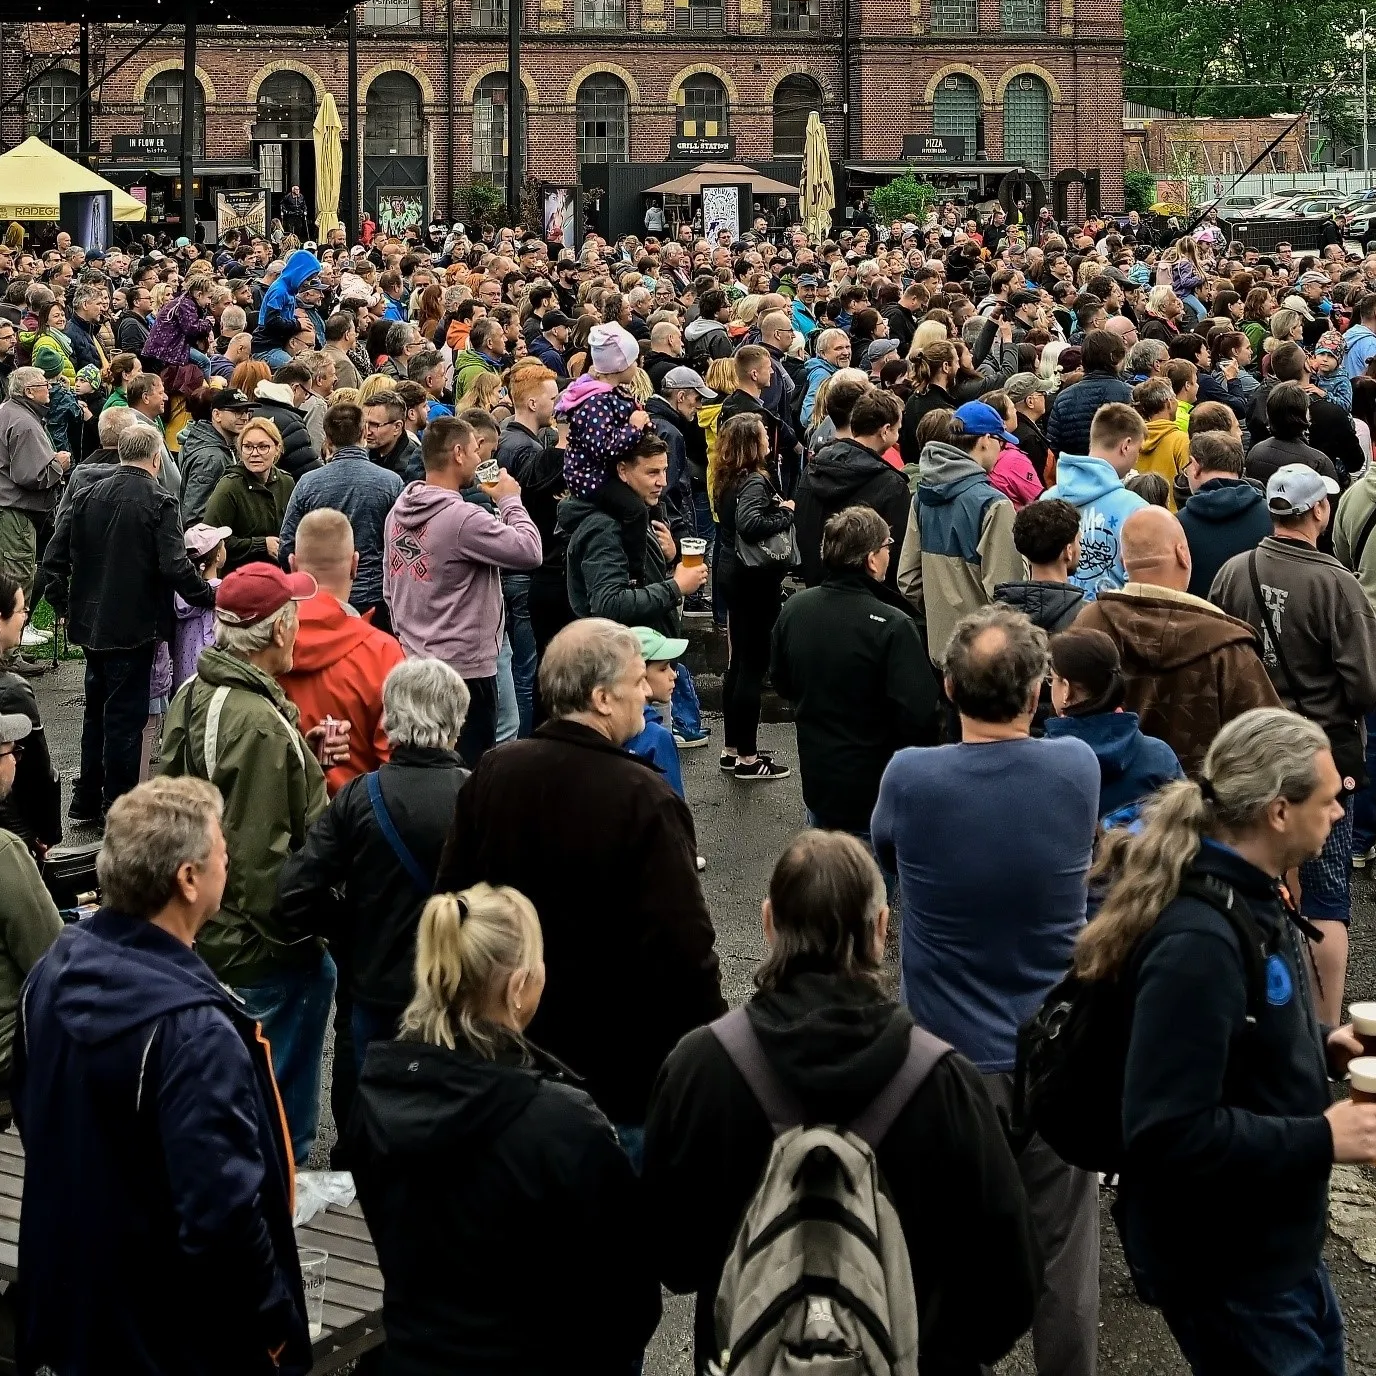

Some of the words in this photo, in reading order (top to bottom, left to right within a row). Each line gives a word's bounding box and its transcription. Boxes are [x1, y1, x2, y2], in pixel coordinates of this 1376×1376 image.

[677, 142, 700, 150] GRILL
[700, 142, 729, 150] STATION
[925, 138, 943, 148] PIZZA
[15, 206, 60, 218] RADEGA
